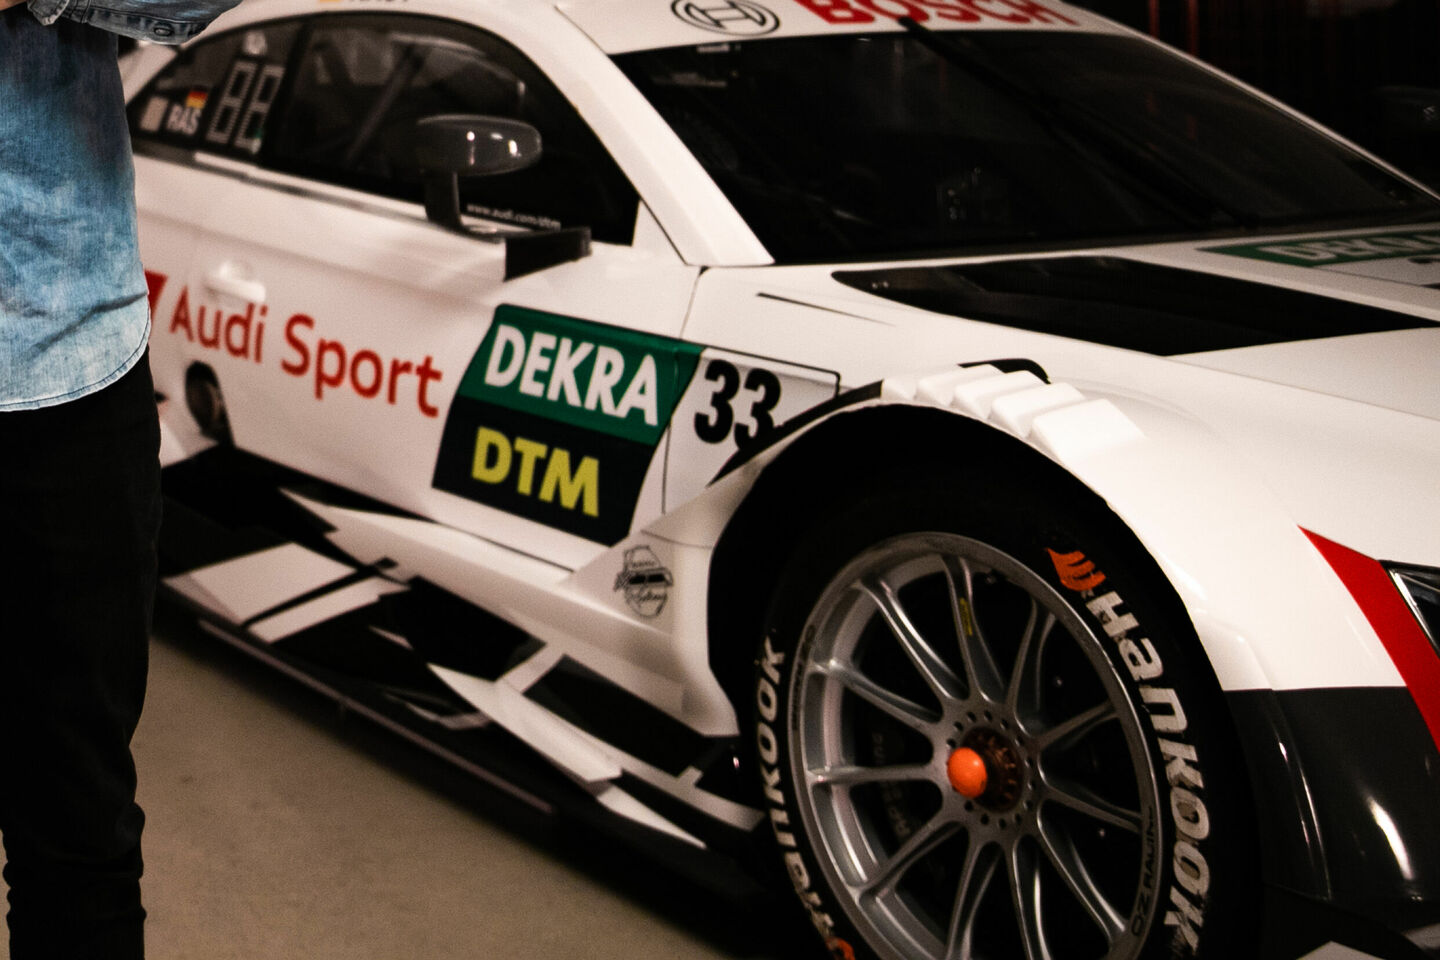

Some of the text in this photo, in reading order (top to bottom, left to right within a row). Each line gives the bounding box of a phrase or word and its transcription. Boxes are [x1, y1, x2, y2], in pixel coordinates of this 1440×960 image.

[168, 283, 443, 420] Audi Sport
[483, 322, 659, 428] DEKRA
[693, 358, 783, 452] 33
[470, 425, 600, 518] DTM
